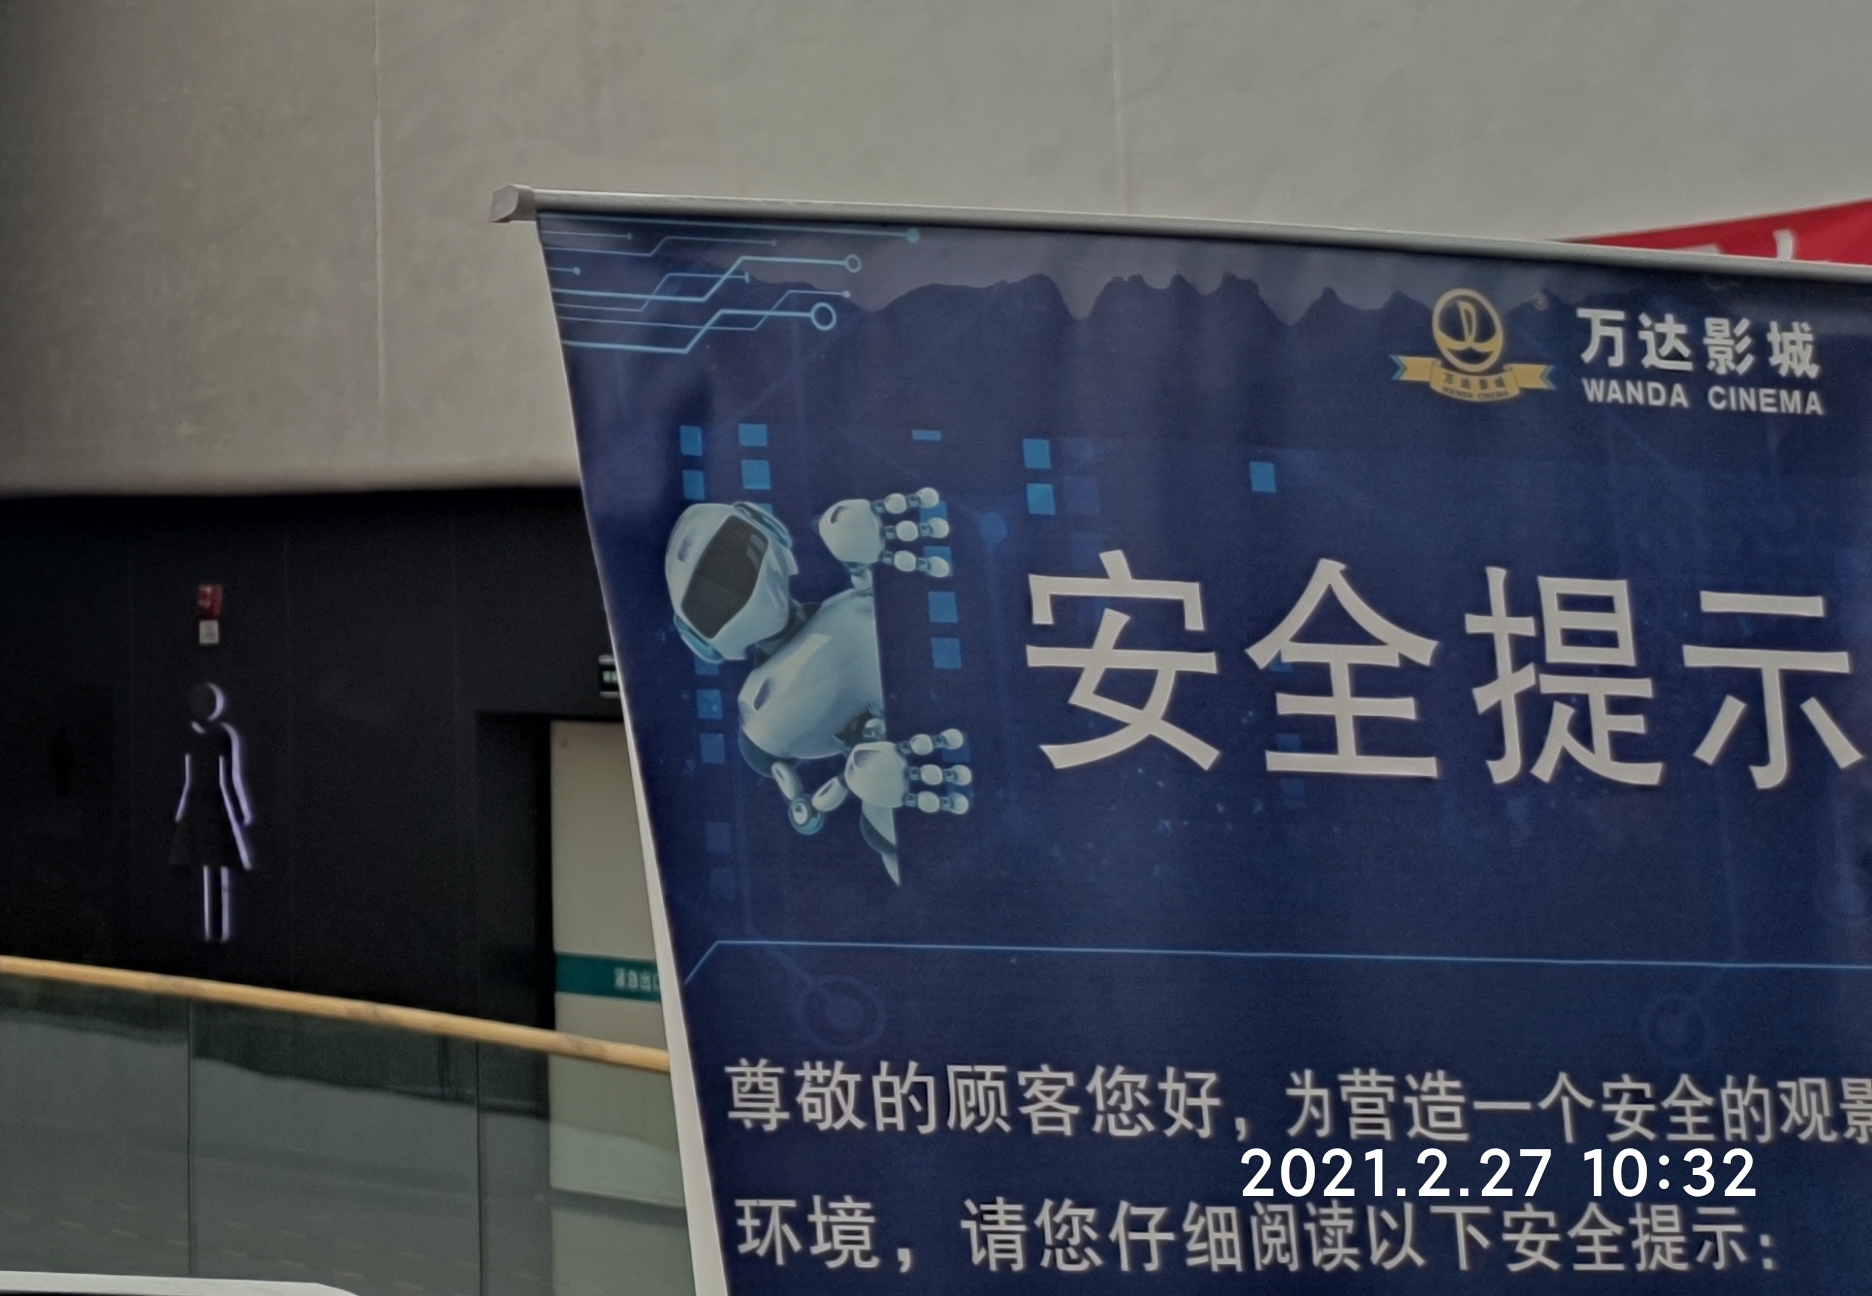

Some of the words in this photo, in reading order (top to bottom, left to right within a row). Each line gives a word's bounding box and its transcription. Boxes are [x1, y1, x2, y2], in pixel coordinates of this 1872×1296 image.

[1575, 307, 1820, 379] 万达影城
[1582, 377, 1689, 408] WANDA
[1708, 386, 1824, 416] CINEMA
[1025, 549, 1863, 791] 安全提示
